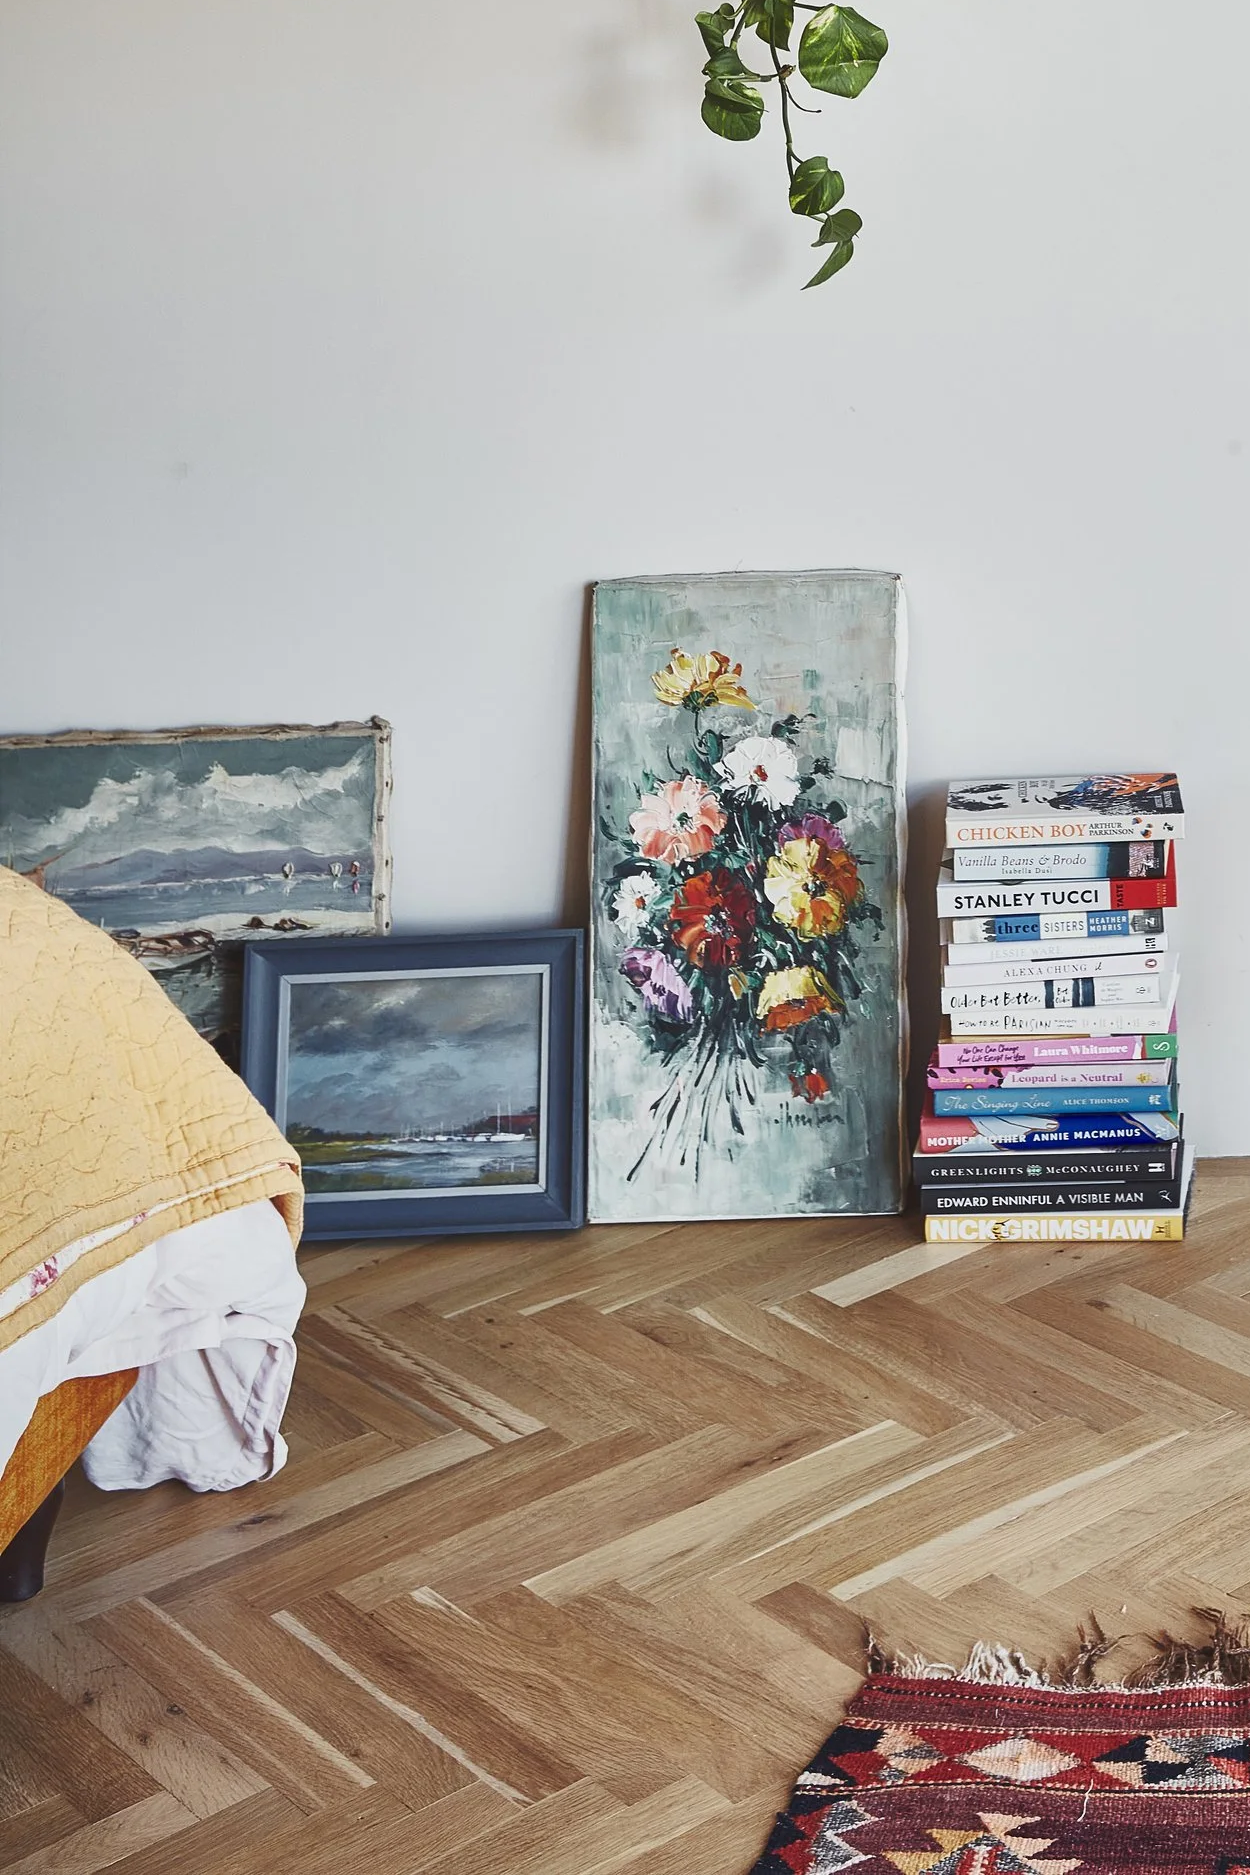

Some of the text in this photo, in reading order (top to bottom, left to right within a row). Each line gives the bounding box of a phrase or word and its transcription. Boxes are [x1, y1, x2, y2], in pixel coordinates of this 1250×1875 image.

[957, 824, 1087, 842] CHICKEN BOY
[1089, 828, 1134, 836] PARKINSON
[958, 854, 1087, 867] Vanilla Beans & Brodo
[954, 890, 1099, 910] STANLEY TUCCI
[1089, 915, 1127, 924] HEATHER
[998, 921, 1084, 935] three SISTERS
[1089, 923, 1122, 932] MORRIS
[1004, 963, 1087, 977] ALEXA CHUNG
[1004, 1015, 1052, 1032] PARISIAN
[985, 1045, 996, 1054] Can
[1033, 1043, 1129, 1057] Laura Whitmore
[1012, 1073, 1057, 1084] Leopard
[1061, 1074, 1068, 1082] is
[1080, 1073, 1123, 1082] Neutral
[943, 1093, 1052, 1113] The Singing Line
[1089, 1097, 1130, 1105] THOMSON
[927, 1128, 1141, 1147] MOTHER MOTHER ANNIE MACMANUS
[930, 1164, 1141, 1176] GREENLIGHTS McCONAUGHEY
[937, 1193, 1144, 1208] EDWARD ENNINFUL A VISIBLE MAN
[930, 1219, 996, 1240] NICK
[1005, 1219, 1155, 1240] GRIMSHAW
